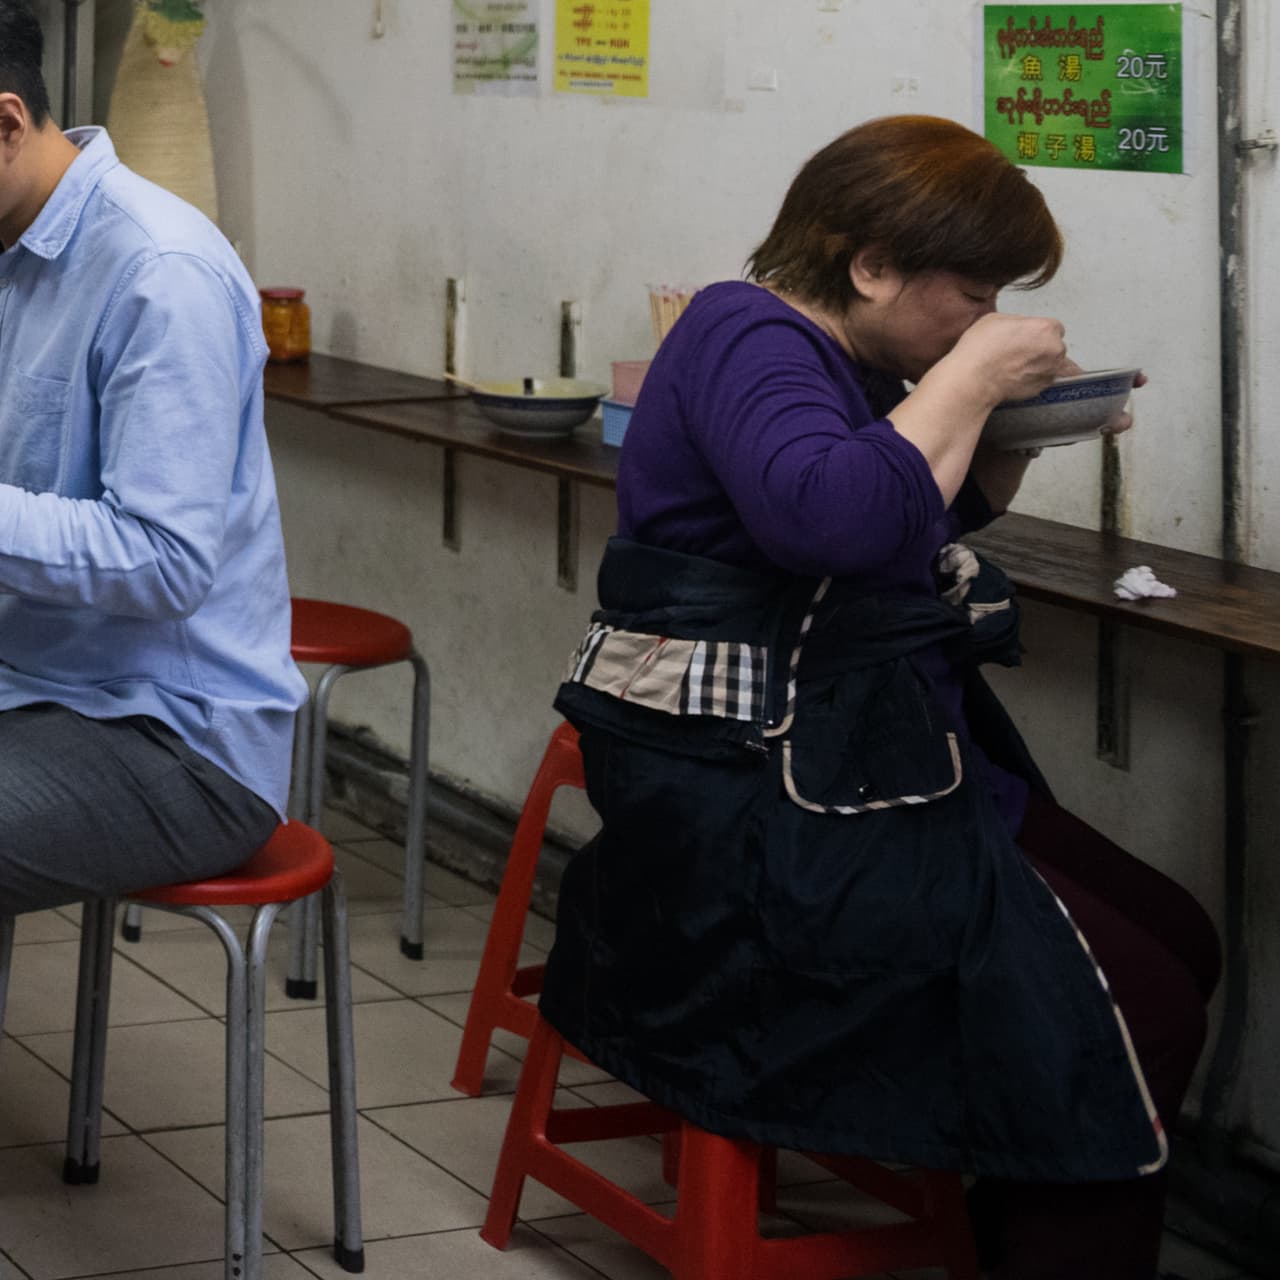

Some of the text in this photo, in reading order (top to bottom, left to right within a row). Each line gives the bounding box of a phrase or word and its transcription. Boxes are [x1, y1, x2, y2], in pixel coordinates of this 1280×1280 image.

[1116, 54, 1168, 78] 20元
[1018, 127, 1169, 161] 椰子湯 20元
